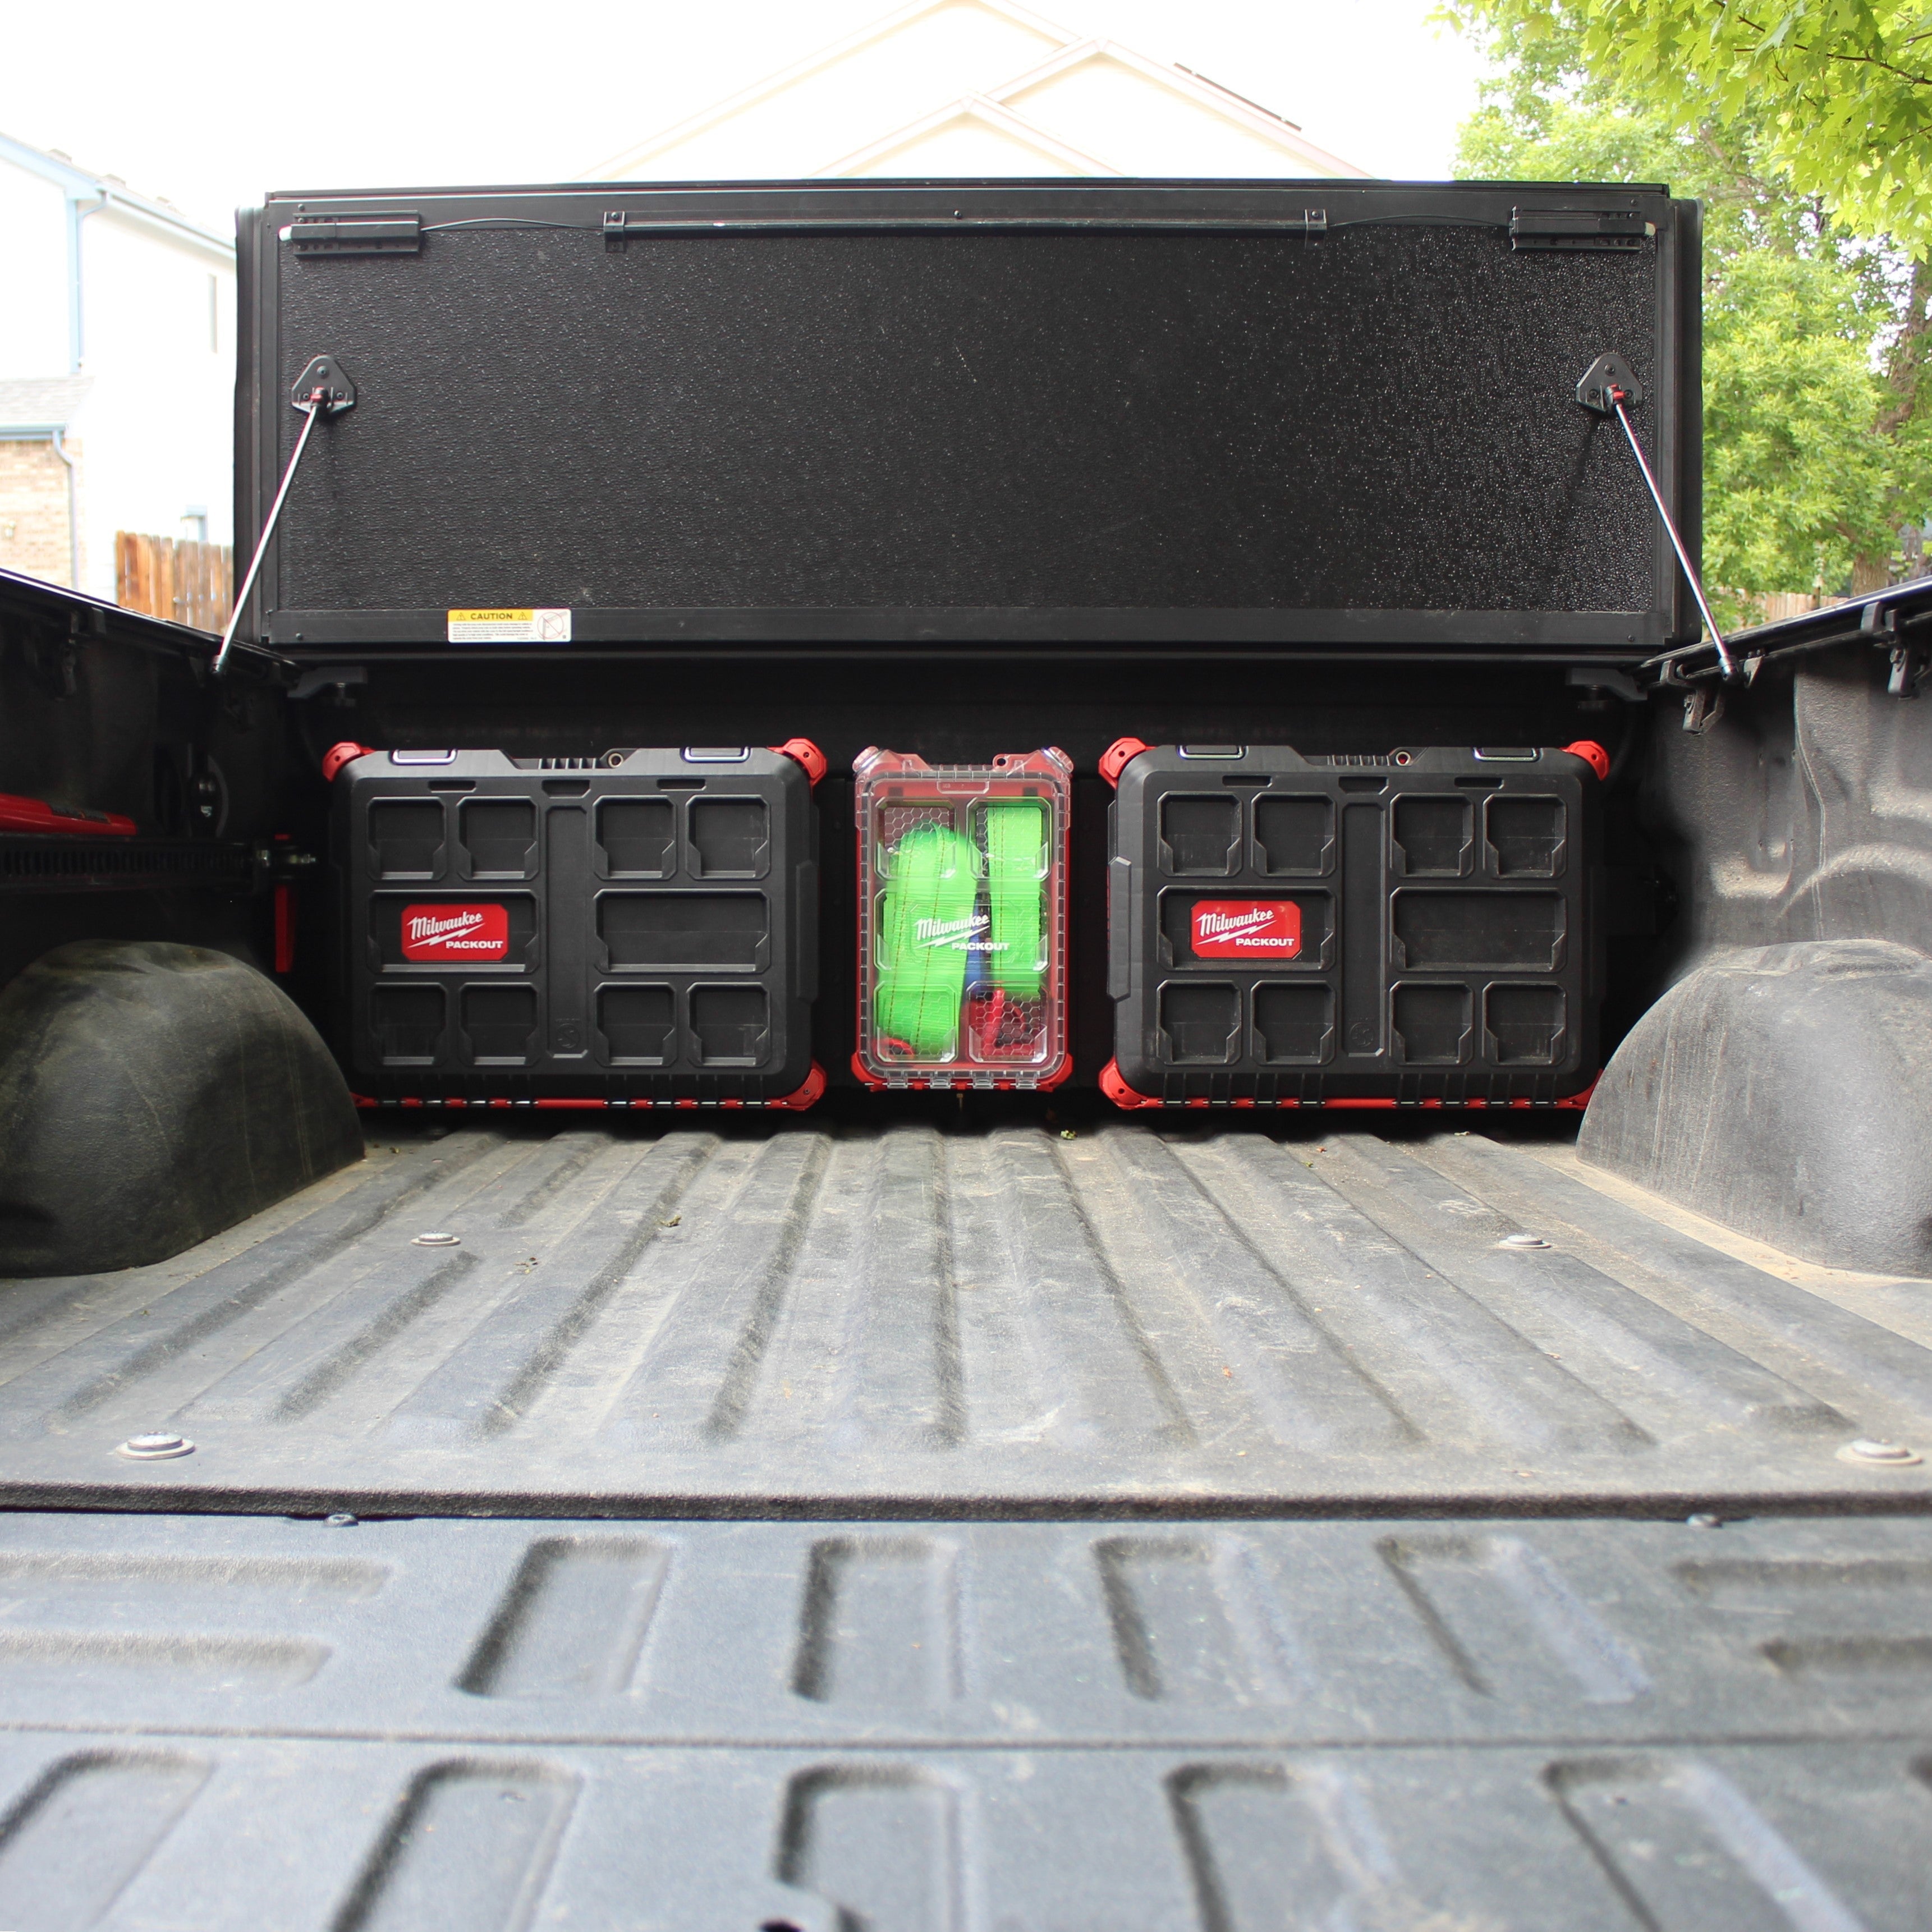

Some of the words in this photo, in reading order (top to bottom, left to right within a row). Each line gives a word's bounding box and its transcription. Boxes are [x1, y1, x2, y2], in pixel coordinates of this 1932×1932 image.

[406, 911, 483, 940] Milwaukee
[914, 914, 990, 941] Milwaukee
[1195, 908, 1275, 937] Milwaukee
[446, 940, 503, 949] PACKOUT
[952, 942, 1009, 951] PACKOUT
[1236, 938, 1295, 947] PACKOUT
